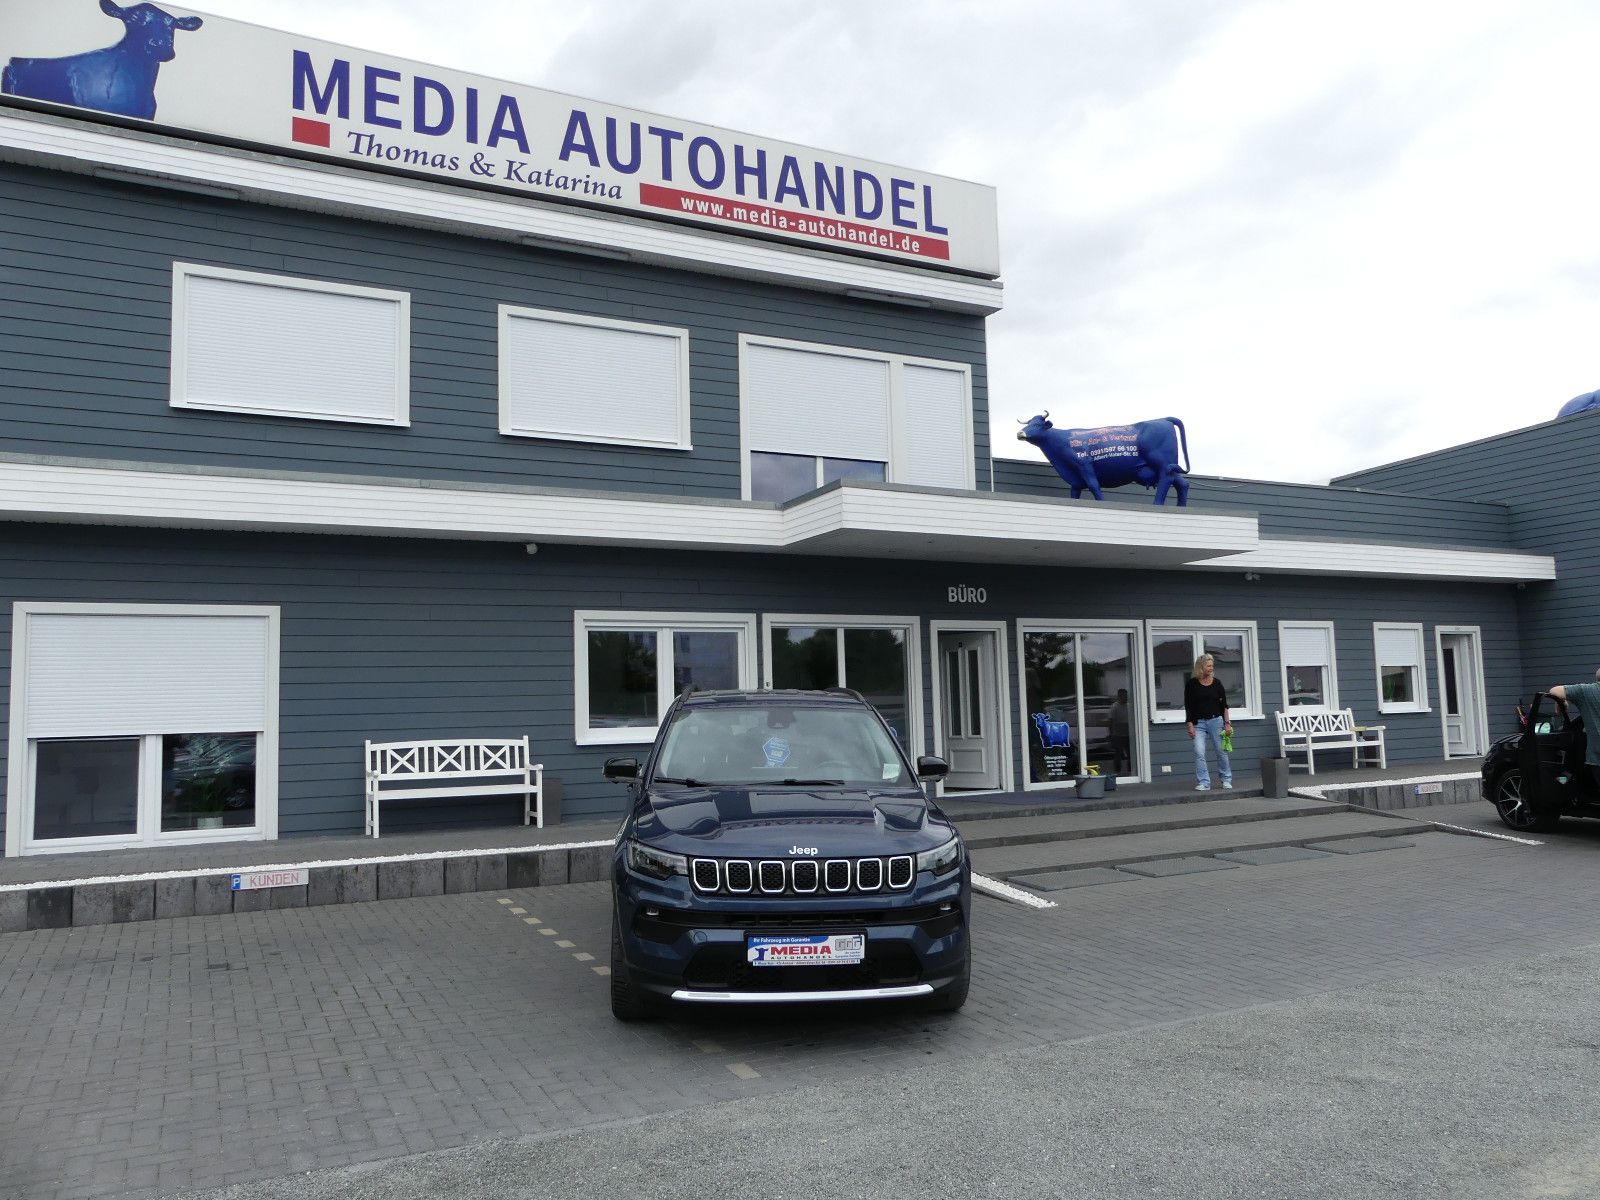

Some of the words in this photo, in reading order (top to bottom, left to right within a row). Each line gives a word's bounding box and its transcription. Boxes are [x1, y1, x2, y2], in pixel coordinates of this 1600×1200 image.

[292, 49, 531, 154] MEDIA
[558, 108, 949, 236] AUTOHANDEL
[347, 131, 460, 171] Thomas
[469, 152, 496, 178] &
[503, 159, 623, 200] Katarina
[680, 195, 921, 254] www.media-autohandel.de
[948, 583, 987, 604] BÜRO
[788, 845, 819, 857] Jeep
[249, 872, 299, 887] KUNDEN
[770, 945, 832, 955] MEDIA
